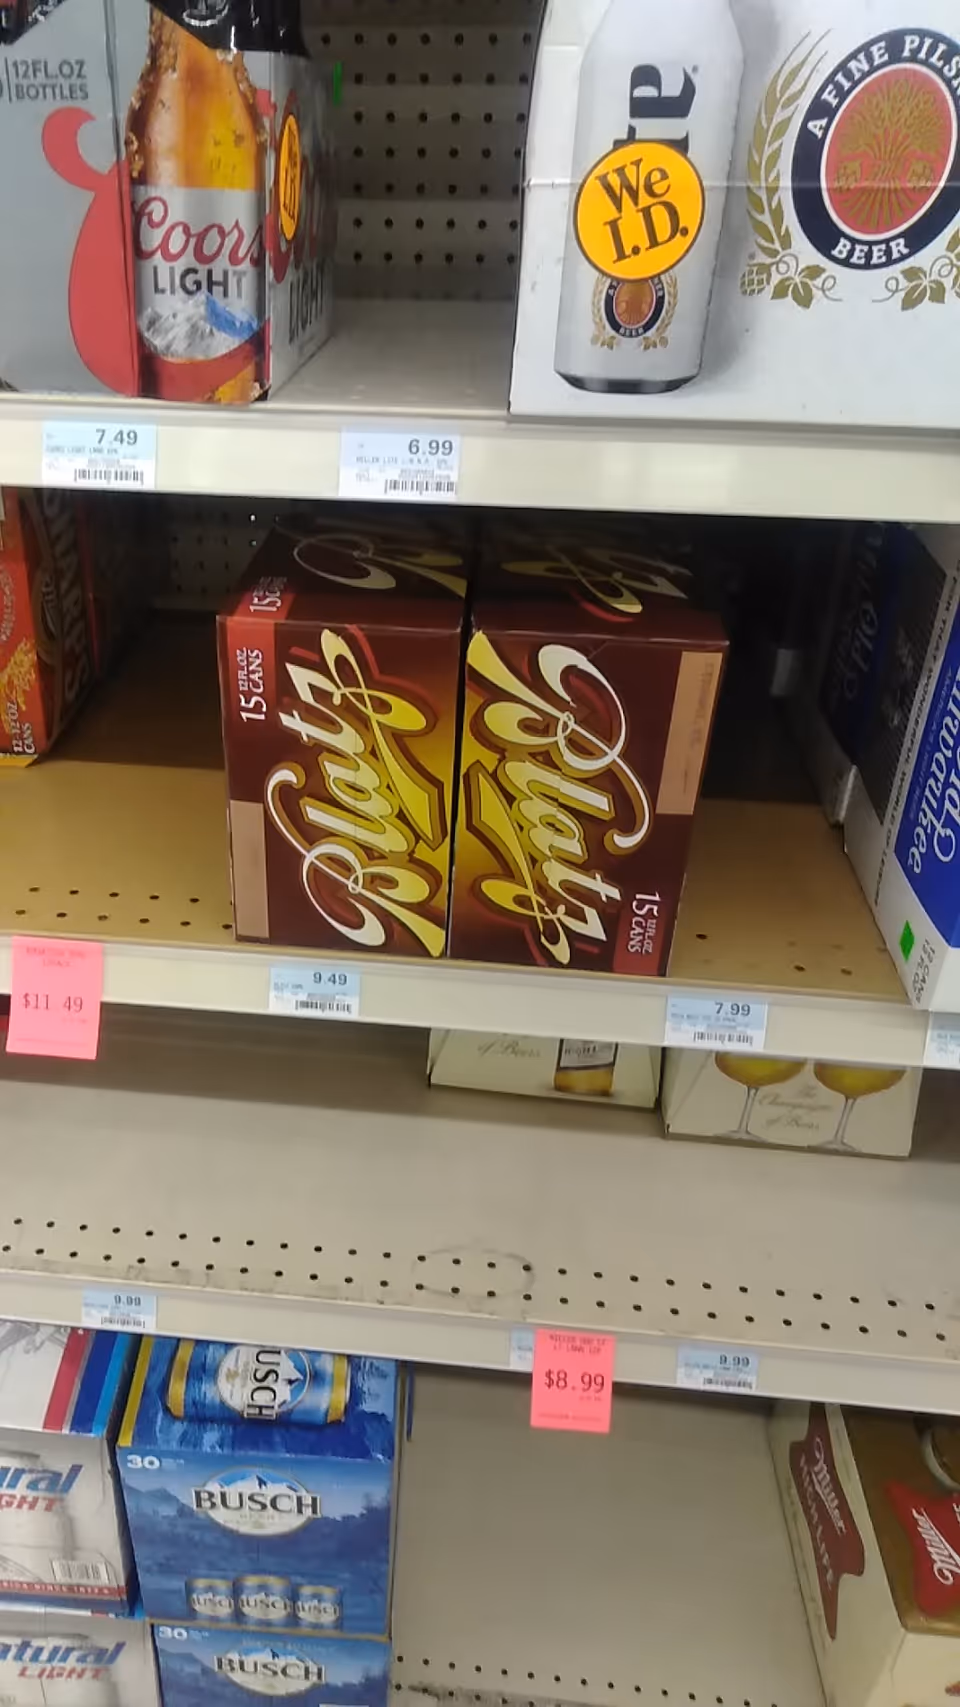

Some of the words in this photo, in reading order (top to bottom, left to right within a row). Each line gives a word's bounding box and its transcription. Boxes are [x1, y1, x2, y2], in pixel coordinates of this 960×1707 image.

[15, 83, 89, 101] BOTTLES
[807, 115, 829, 139] A
[820, 40, 890, 109] FINE
[595, 158, 671, 219] We
[134, 196, 270, 267] Coors
[603, 199, 690, 265] I.D.
[831, 237, 910, 266] BEER
[152, 265, 248, 296] LIGHT
[289, 258, 324, 345] LIGHT
[95, 428, 139, 446] 7.49
[407, 438, 454, 457] 6.99
[247, 649, 264, 694] CANS
[239, 694, 267, 722] 15
[905, 667, 934, 763] WONDERFUL
[22, 721, 35, 754] CANS
[267, 628, 447, 958] Blatz
[466, 630, 651, 965] Blatz
[632, 891, 661, 917] 15
[627, 916, 646, 953] CANS
[313, 971, 348, 986] 9.49
[714, 1000, 751, 1016] 7.99
[246, 1348, 281, 1419] USCH
[544, 1368, 605, 1394] $8.99
[126, 1454, 160, 1470] 30
[811, 1437, 847, 1535] Miller
[193, 1488, 319, 1516] BUSCH
[912, 1507, 960, 1586] Miller
[158, 1626, 189, 1641] 30
[17, 1665, 112, 1681] LIGHT
[216, 1656, 325, 1682] BUSCH
